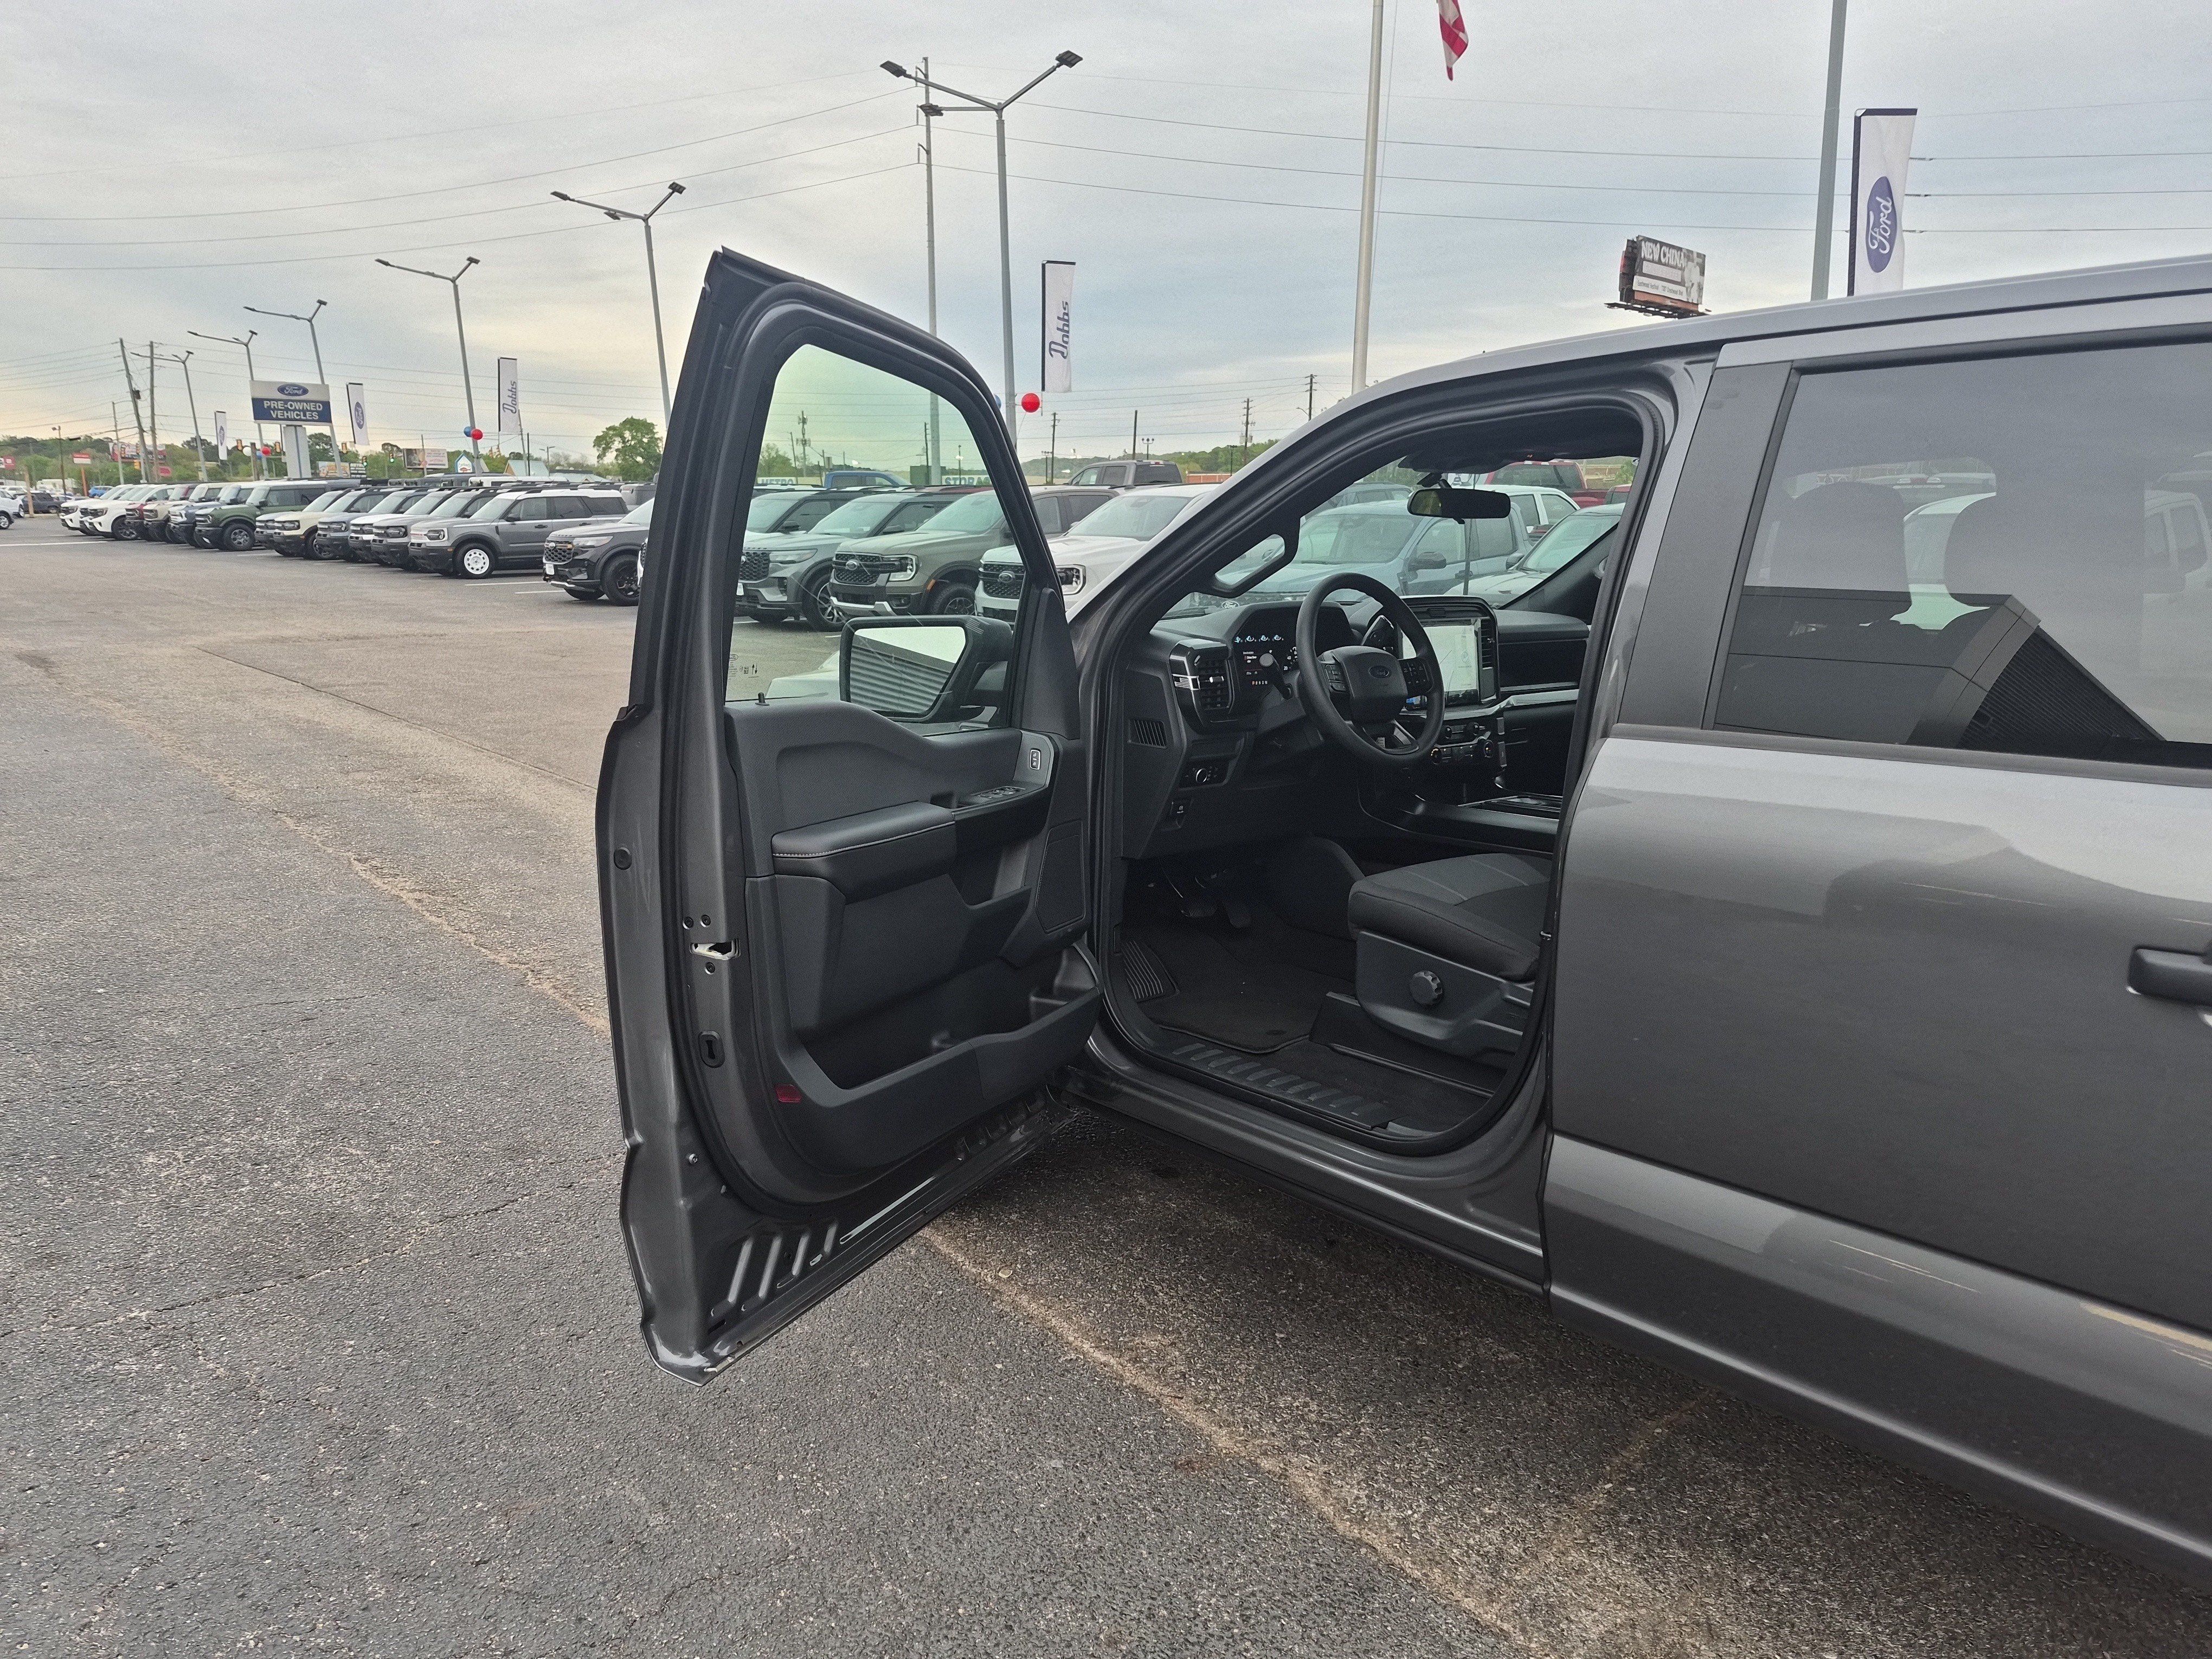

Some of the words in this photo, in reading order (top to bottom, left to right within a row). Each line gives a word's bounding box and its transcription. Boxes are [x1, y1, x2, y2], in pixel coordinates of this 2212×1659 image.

[1868, 196, 1893, 254] Ford
[1641, 240, 1660, 262] NEW
[1660, 245, 1686, 268] CHINA
[1049, 300, 1070, 359] Dobbs
[284, 385, 303, 394] Ford
[502, 381, 517, 414] Dobbs
[263, 400, 323, 411] PRE-OWNED
[271, 410, 319, 420] VEHICLES
